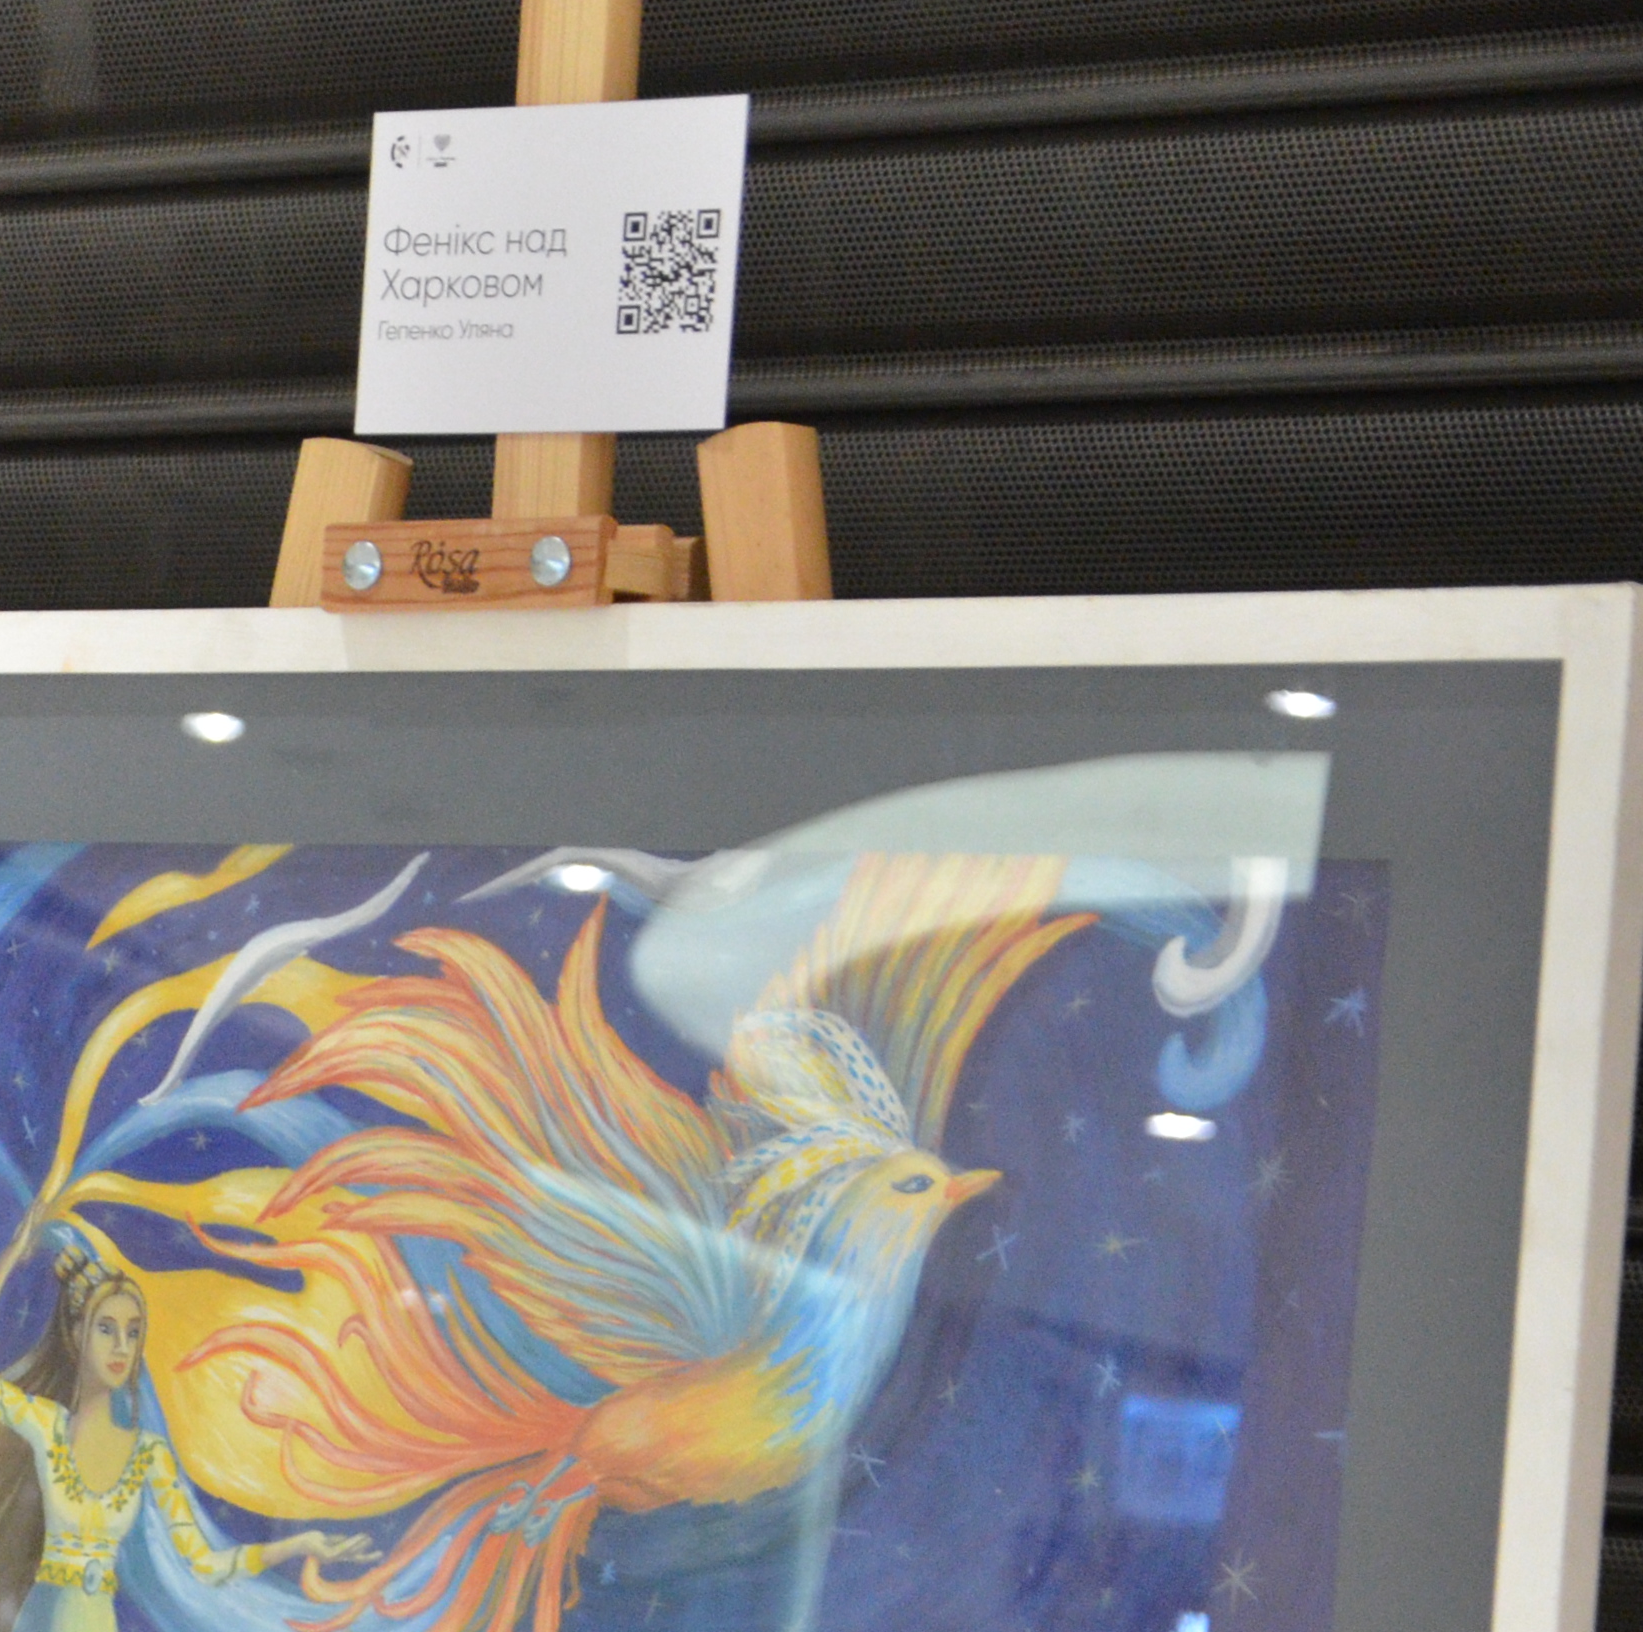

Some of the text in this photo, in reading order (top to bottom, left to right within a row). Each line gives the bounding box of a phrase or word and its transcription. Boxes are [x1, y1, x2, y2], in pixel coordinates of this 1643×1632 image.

[382, 224, 568, 258] Фенікс над
[380, 269, 544, 308] Харковом
[458, 318, 514, 340] Уляна
